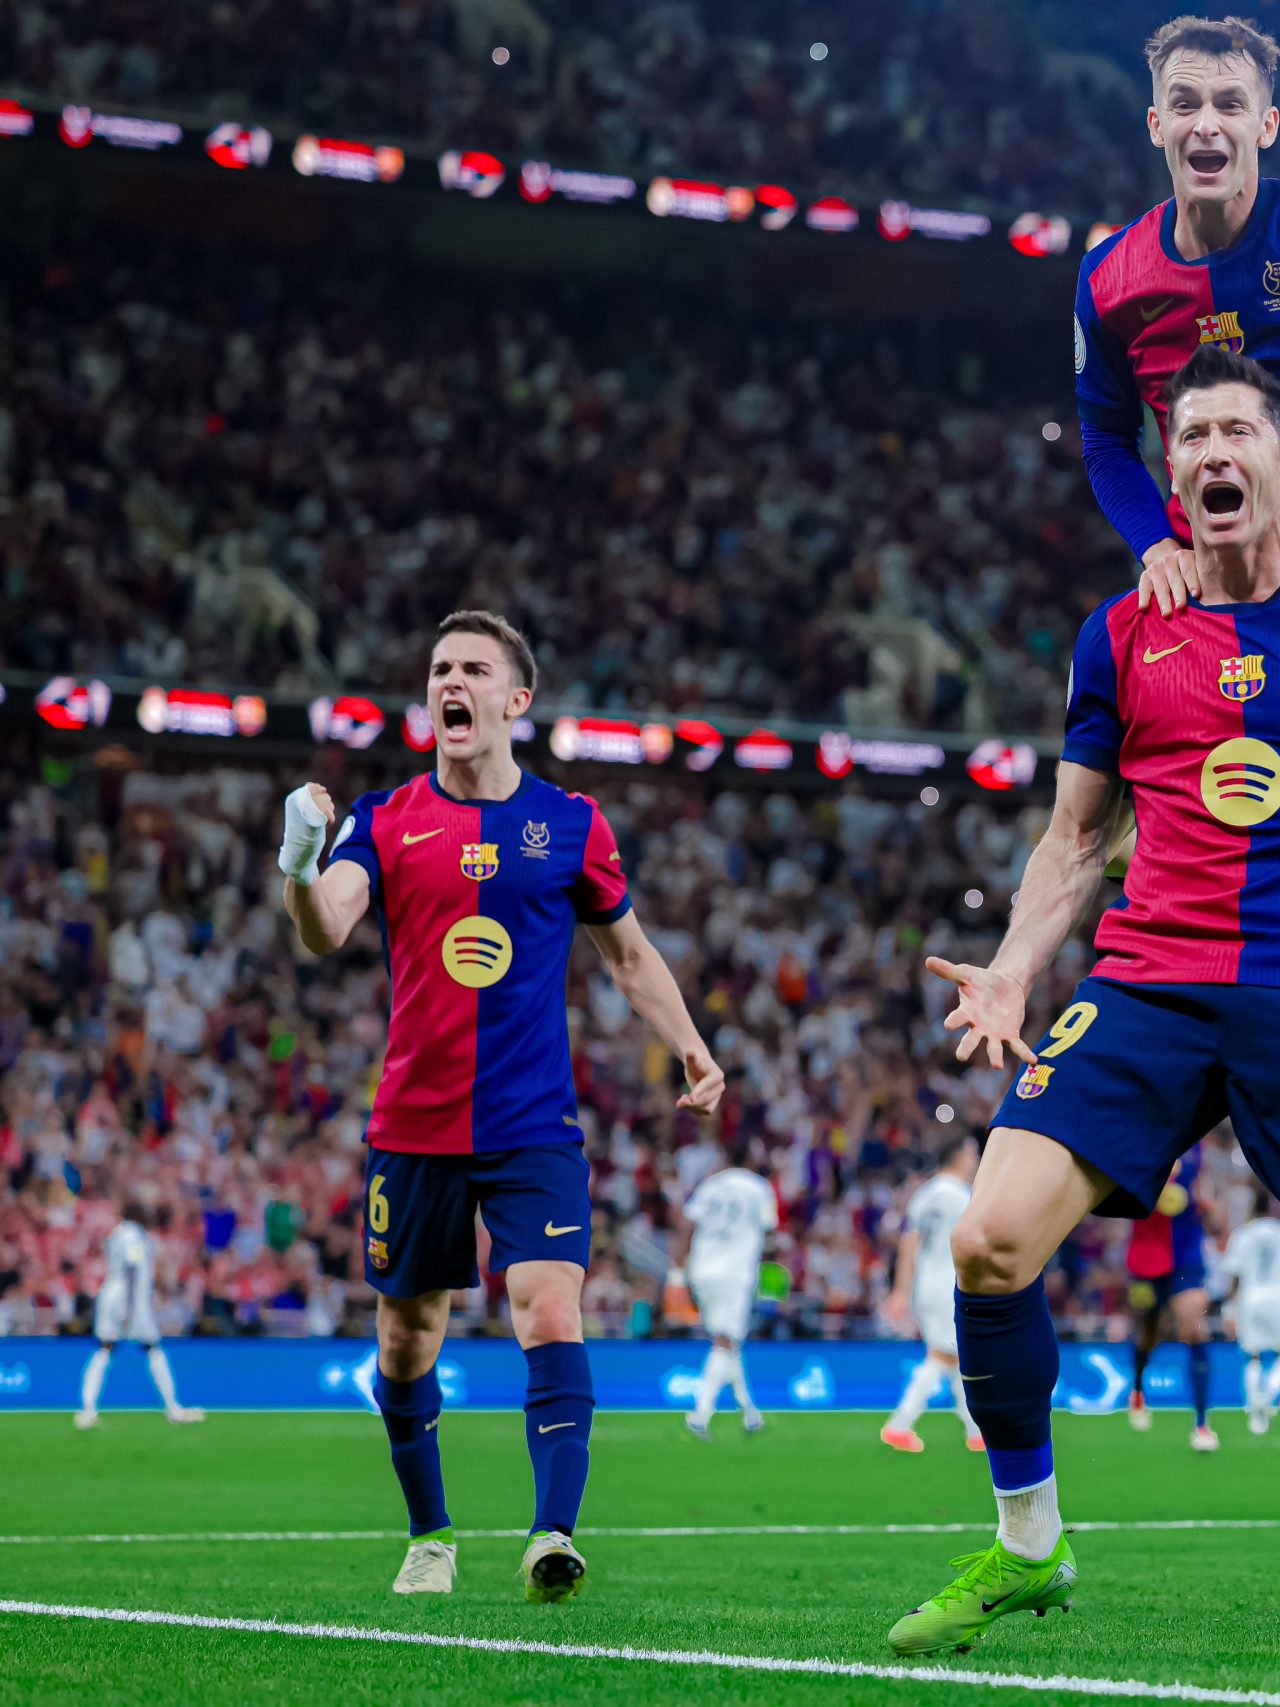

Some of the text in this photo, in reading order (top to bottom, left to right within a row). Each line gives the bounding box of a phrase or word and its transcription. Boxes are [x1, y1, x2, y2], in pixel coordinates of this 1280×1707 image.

[1212, 331, 1230, 340] FCB
[1233, 674, 1251, 682] FCB
[1037, 1001, 1098, 1058] 9
[369, 1173, 388, 1234] 6
